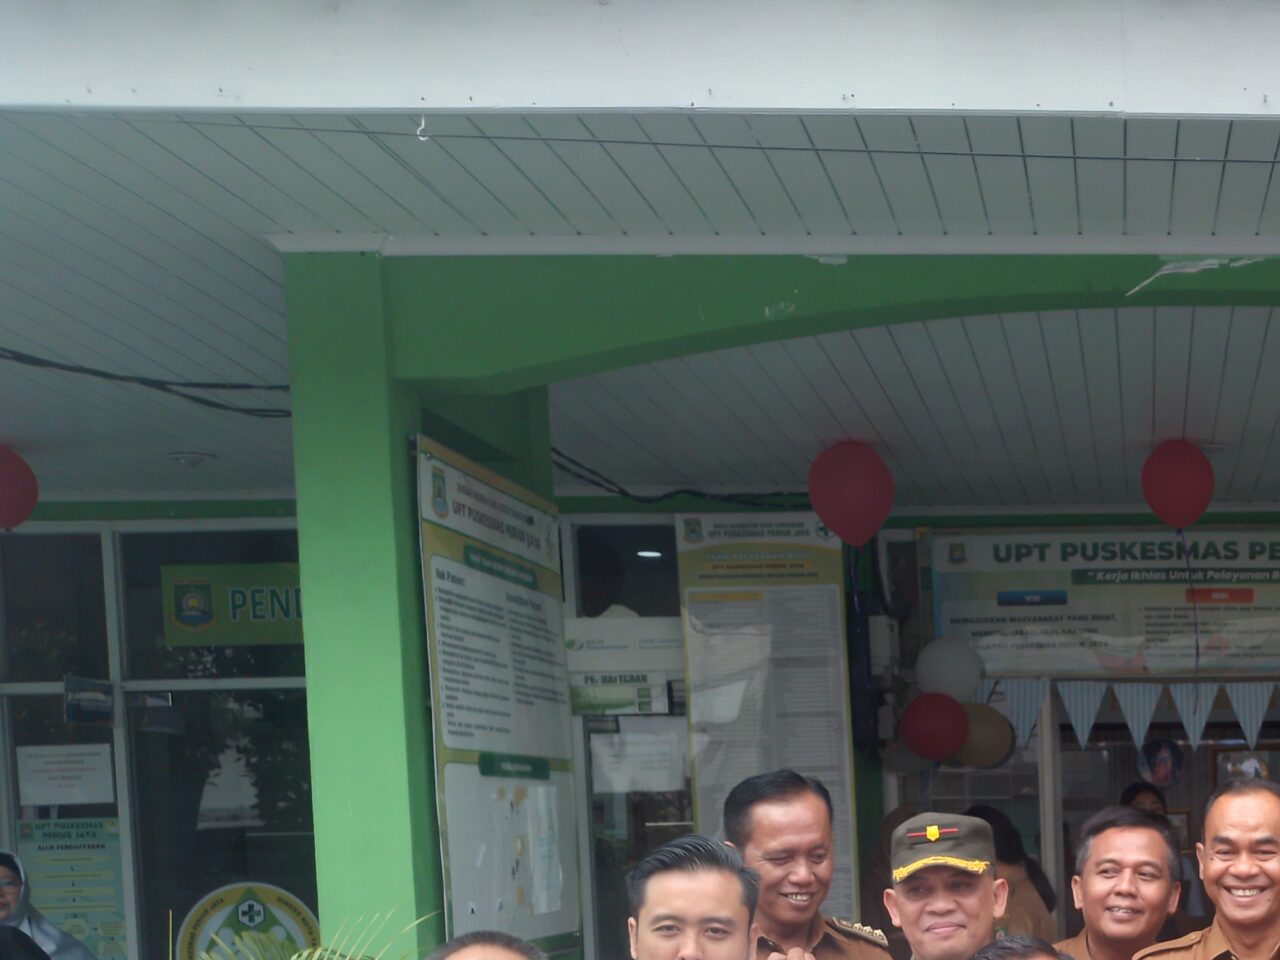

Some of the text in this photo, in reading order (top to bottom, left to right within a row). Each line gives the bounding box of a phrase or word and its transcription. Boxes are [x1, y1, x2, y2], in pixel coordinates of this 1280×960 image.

[452, 500, 467, 518] UPT
[468, 506, 505, 535] PUSKESMAS
[992, 543, 1051, 564] UPT
[1060, 541, 1239, 562] PUSKESMAS
[1095, 570, 1129, 582] Kerja
[1130, 570, 1167, 581] Ikhlas
[1206, 570, 1270, 583] Pelayanan
[76, 830, 97, 838] JAYA
